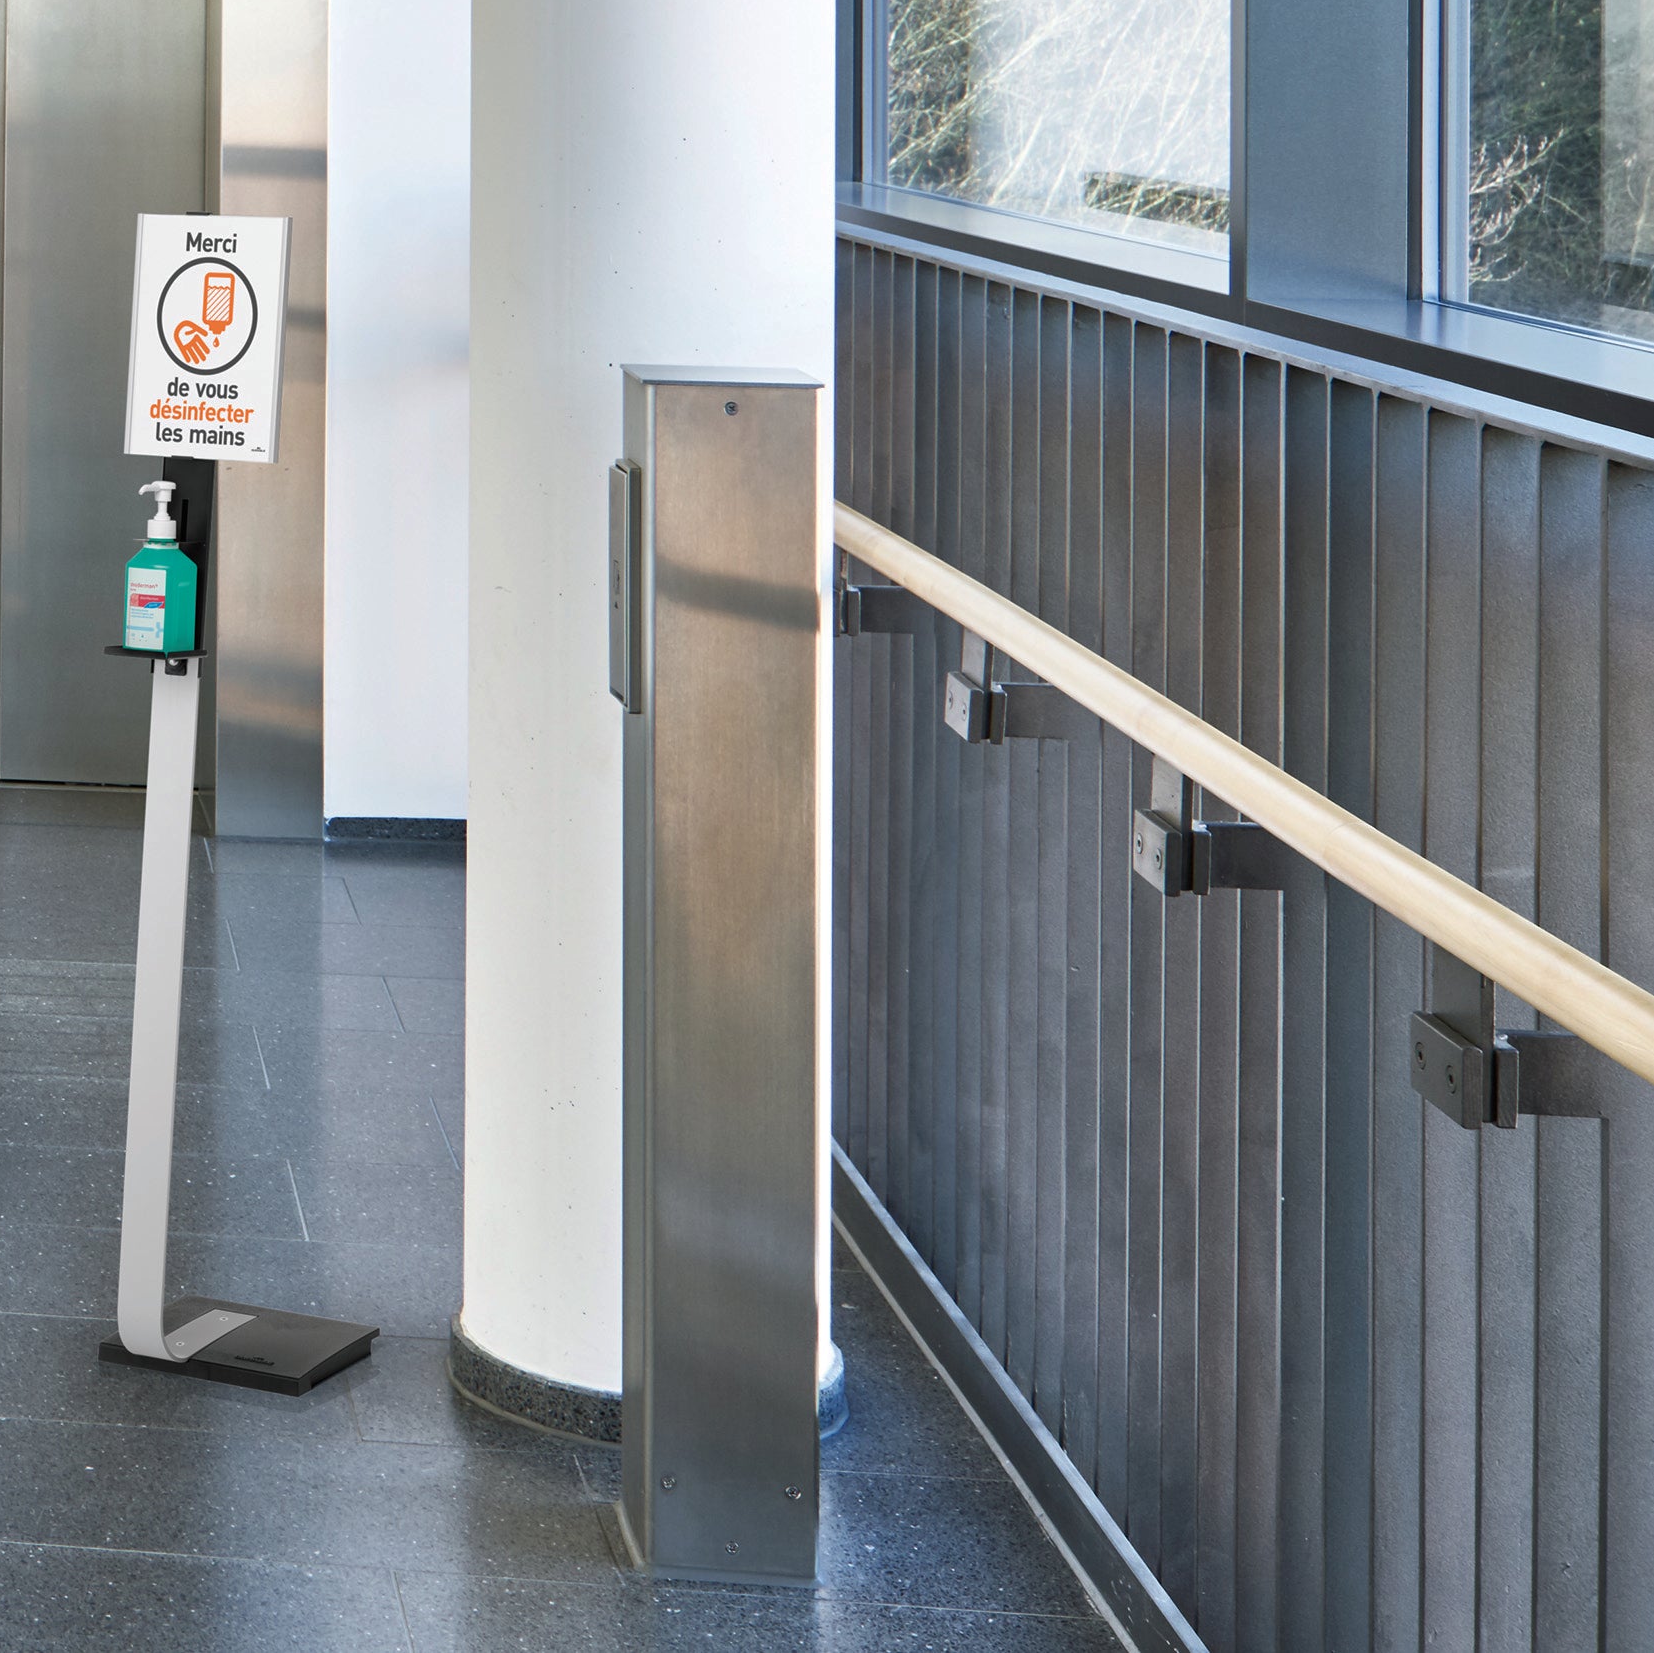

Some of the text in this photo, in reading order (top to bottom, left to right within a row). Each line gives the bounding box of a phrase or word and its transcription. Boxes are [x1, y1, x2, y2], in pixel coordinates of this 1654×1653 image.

[185, 231, 238, 254] Merci
[167, 377, 239, 401] de vous
[149, 397, 255, 425] désinfecter
[155, 422, 246, 447] les mains
